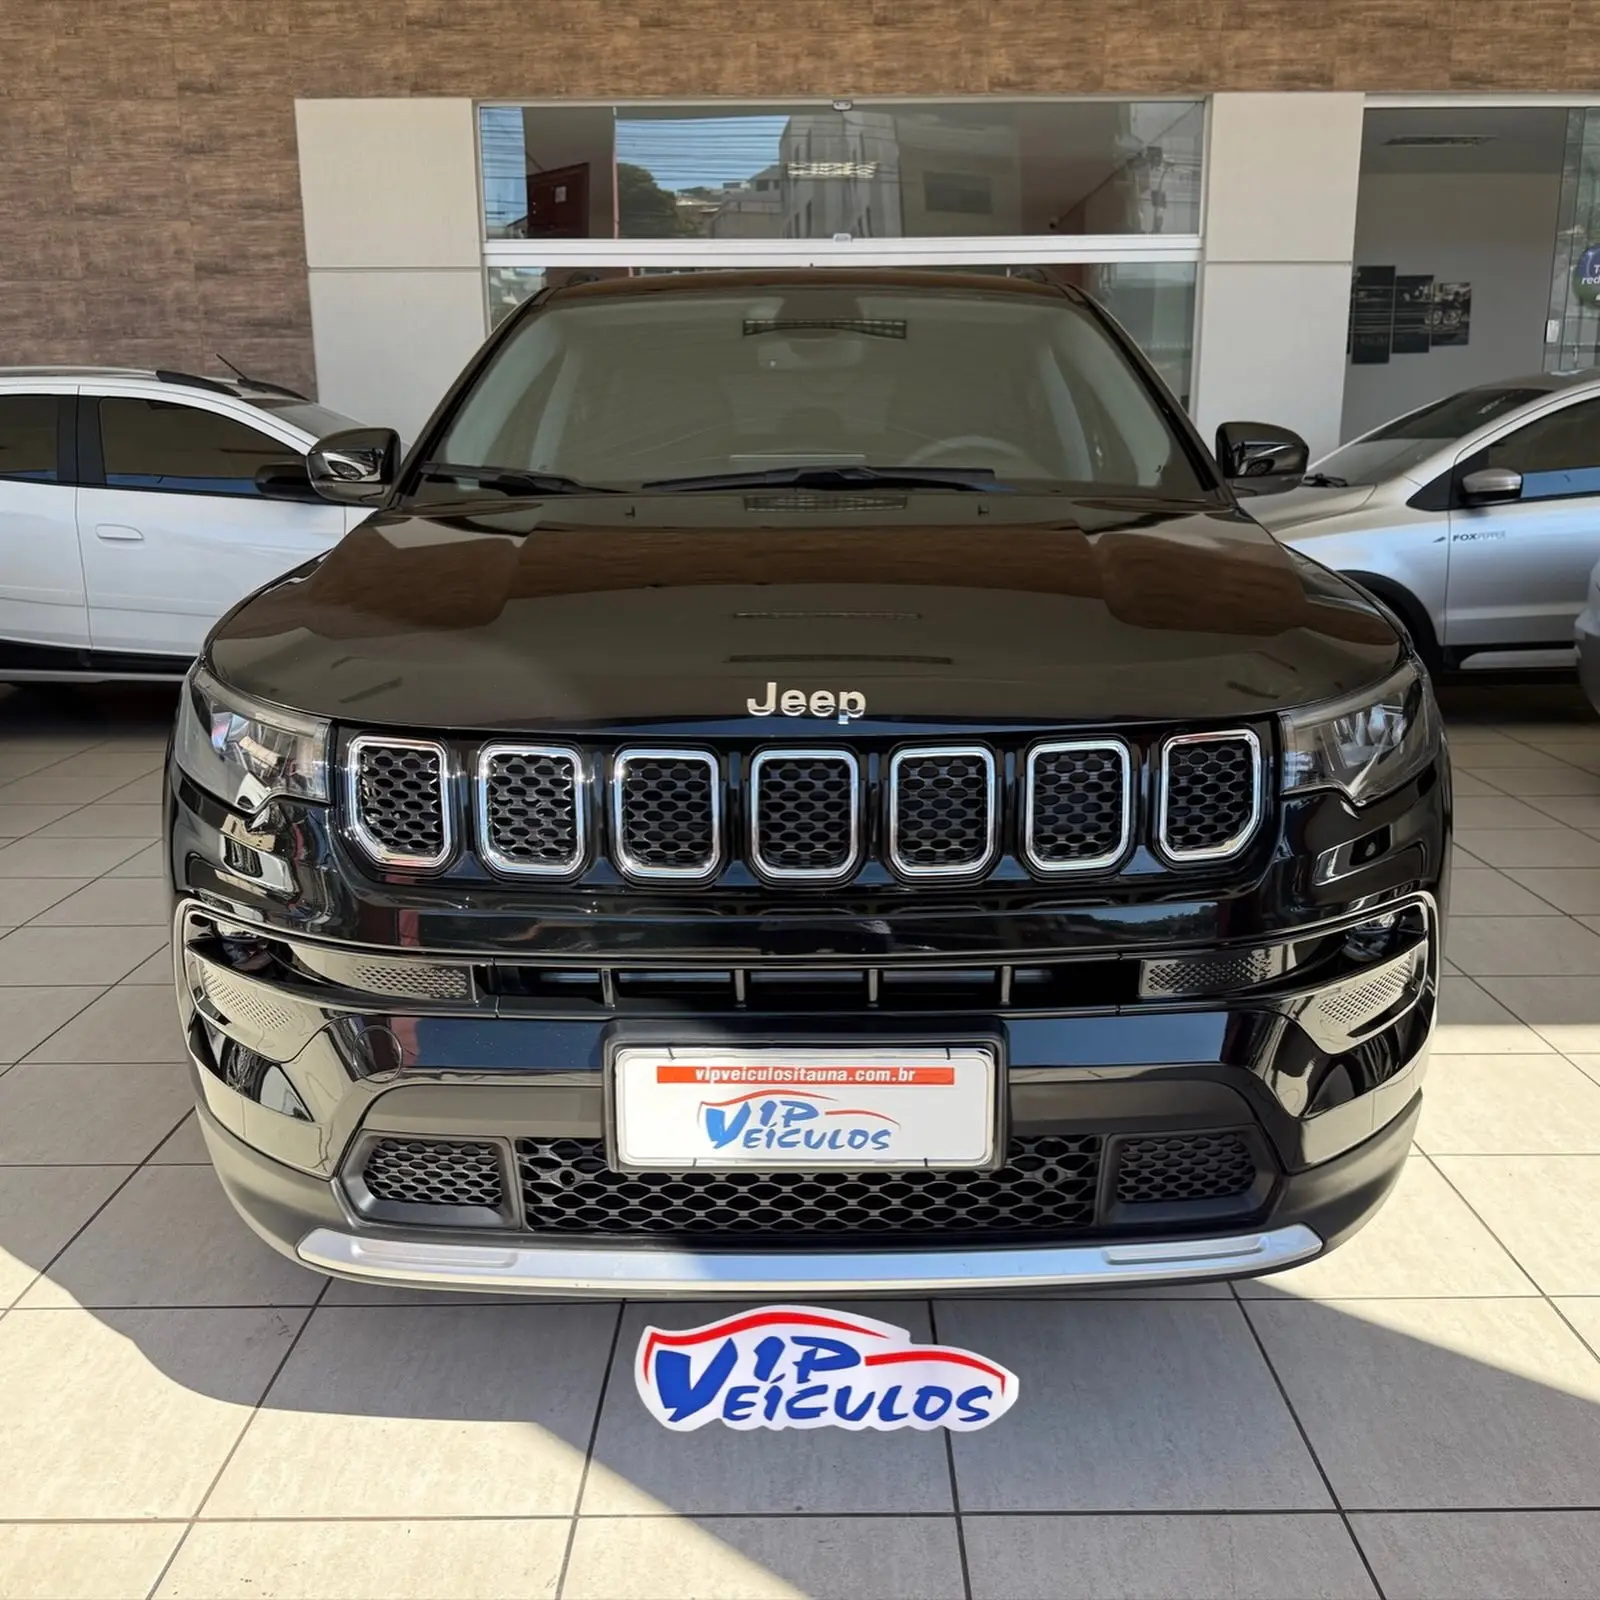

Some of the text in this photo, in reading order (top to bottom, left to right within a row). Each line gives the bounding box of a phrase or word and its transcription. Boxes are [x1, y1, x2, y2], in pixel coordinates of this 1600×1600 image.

[746, 682, 866, 725] Jeep
[695, 1066, 916, 1084] vipveiculositauna.com.br
[705, 1099, 820, 1150] VIP
[655, 1335, 862, 1423] VIP
